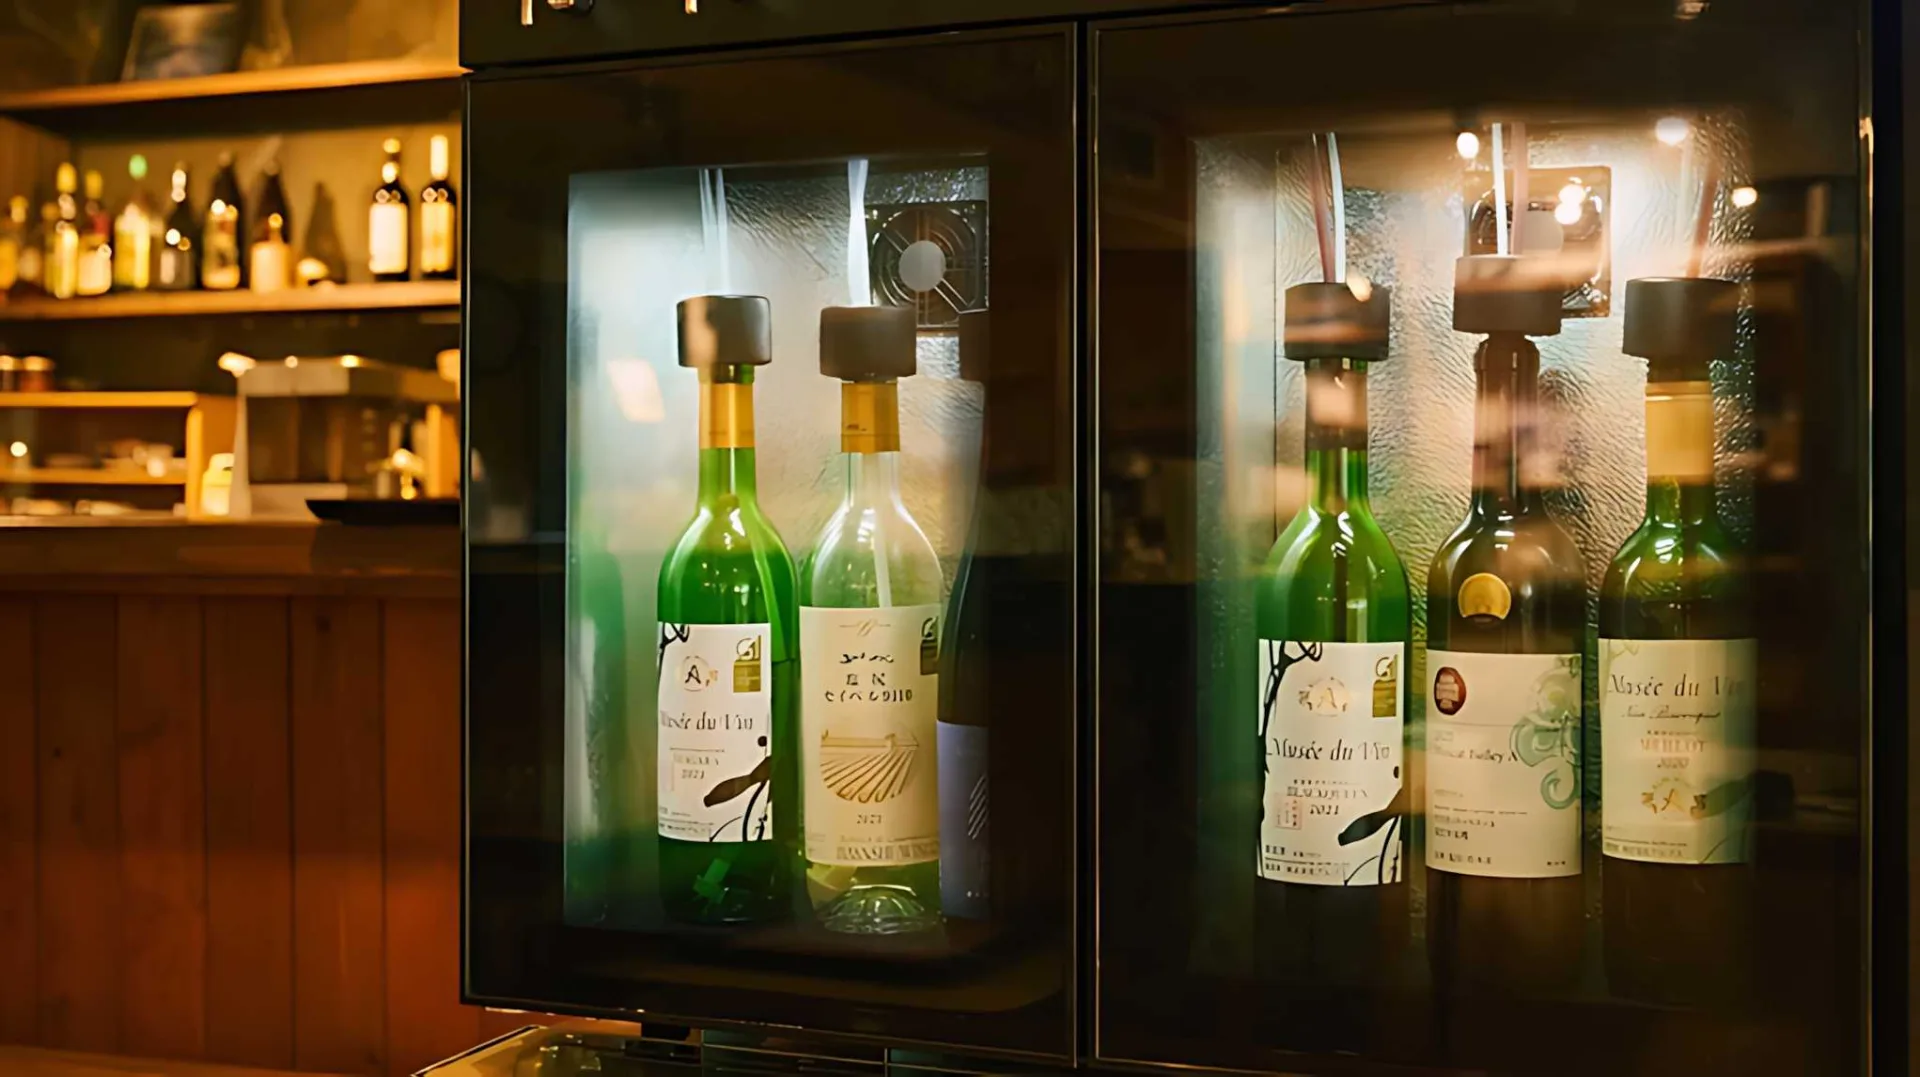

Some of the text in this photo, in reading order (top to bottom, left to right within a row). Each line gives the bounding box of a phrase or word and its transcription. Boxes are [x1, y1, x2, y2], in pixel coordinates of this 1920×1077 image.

[1674, 673, 1699, 697] du
[696, 711, 716, 730] du
[1330, 739, 1353, 761] du
